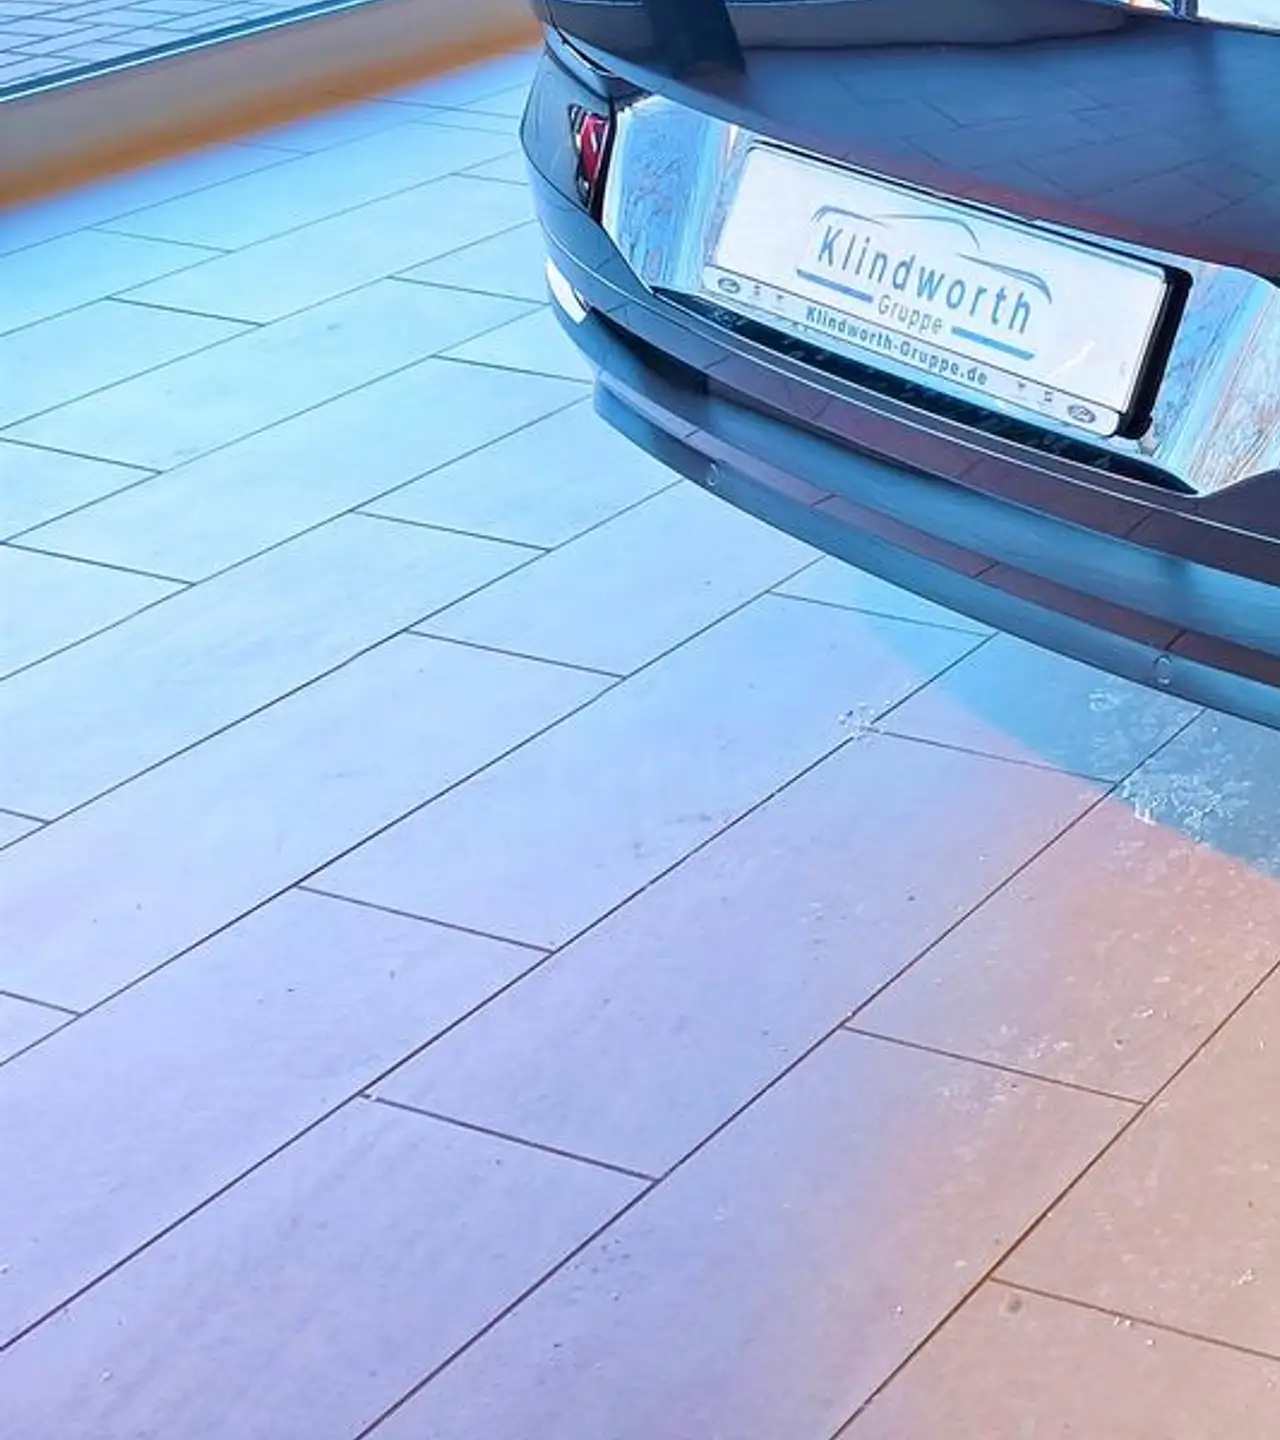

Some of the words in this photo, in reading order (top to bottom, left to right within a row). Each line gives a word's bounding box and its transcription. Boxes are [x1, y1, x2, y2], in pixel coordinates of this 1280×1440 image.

[817, 224, 1032, 335] Klindworth
[878, 293, 944, 336] Gruppe
[805, 304, 988, 387] Klindworth-Gruppe.de
